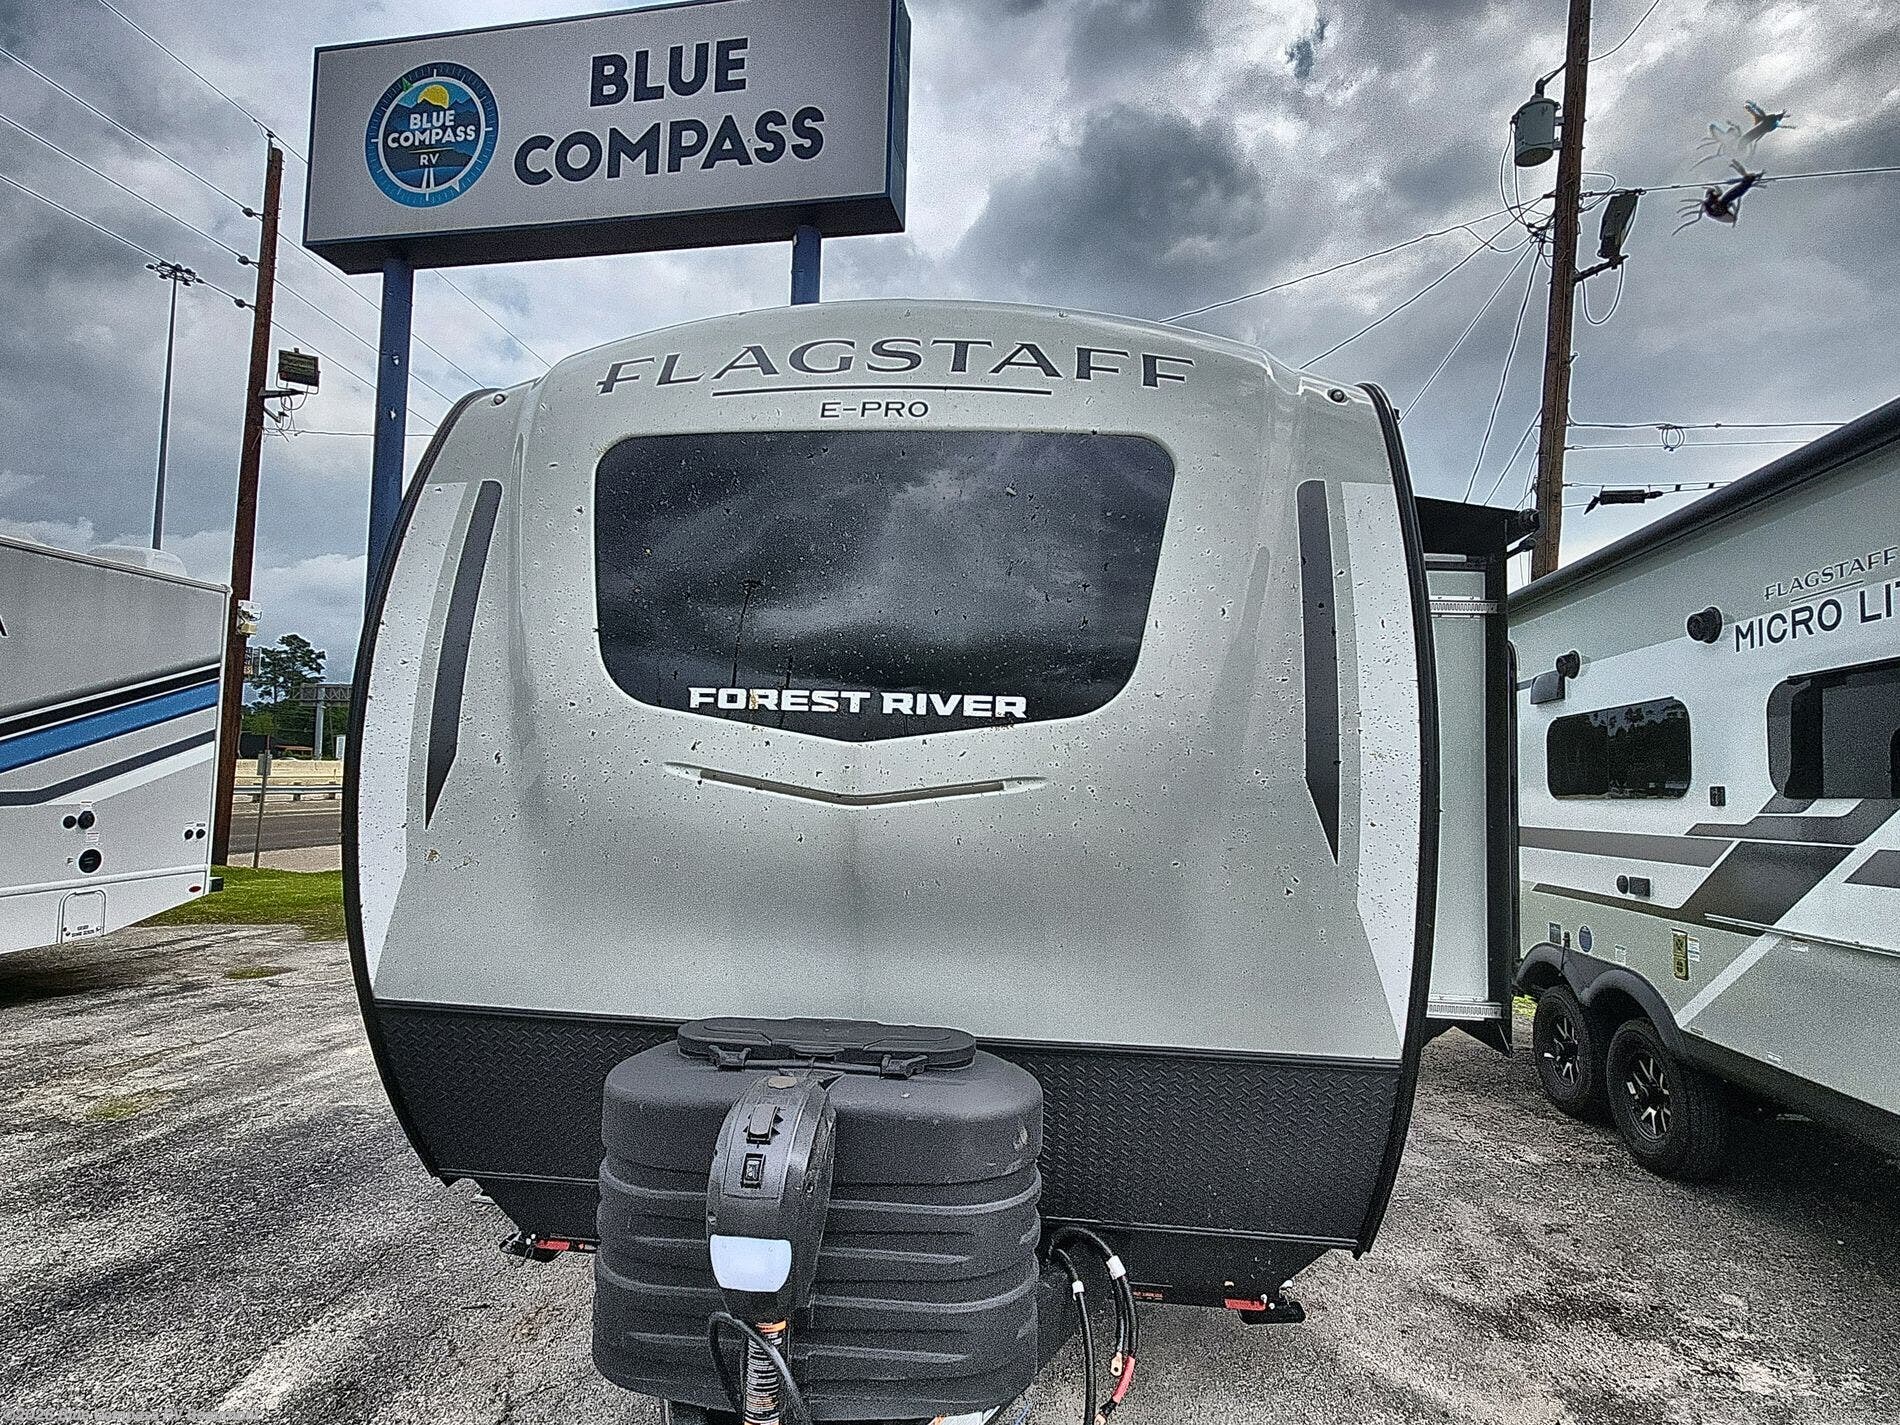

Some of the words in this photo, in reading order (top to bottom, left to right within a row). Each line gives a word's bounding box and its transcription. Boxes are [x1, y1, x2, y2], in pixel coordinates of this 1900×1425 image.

[590, 37, 749, 108] BLUE
[387, 125, 476, 148] COMPASS
[409, 110, 456, 129] BLUE
[419, 153, 440, 166] RV
[513, 105, 825, 187] COMPASS
[596, 338, 1195, 395] FLAGSTAFF
[820, 401, 929, 419] E-PRO
[1763, 546, 1899, 601] FLAGSTAFF
[1735, 598, 1842, 653] MICRO
[1858, 580, 1900, 624] LI
[688, 686, 870, 714] FOREST
[881, 691, 1027, 719] RIVER
